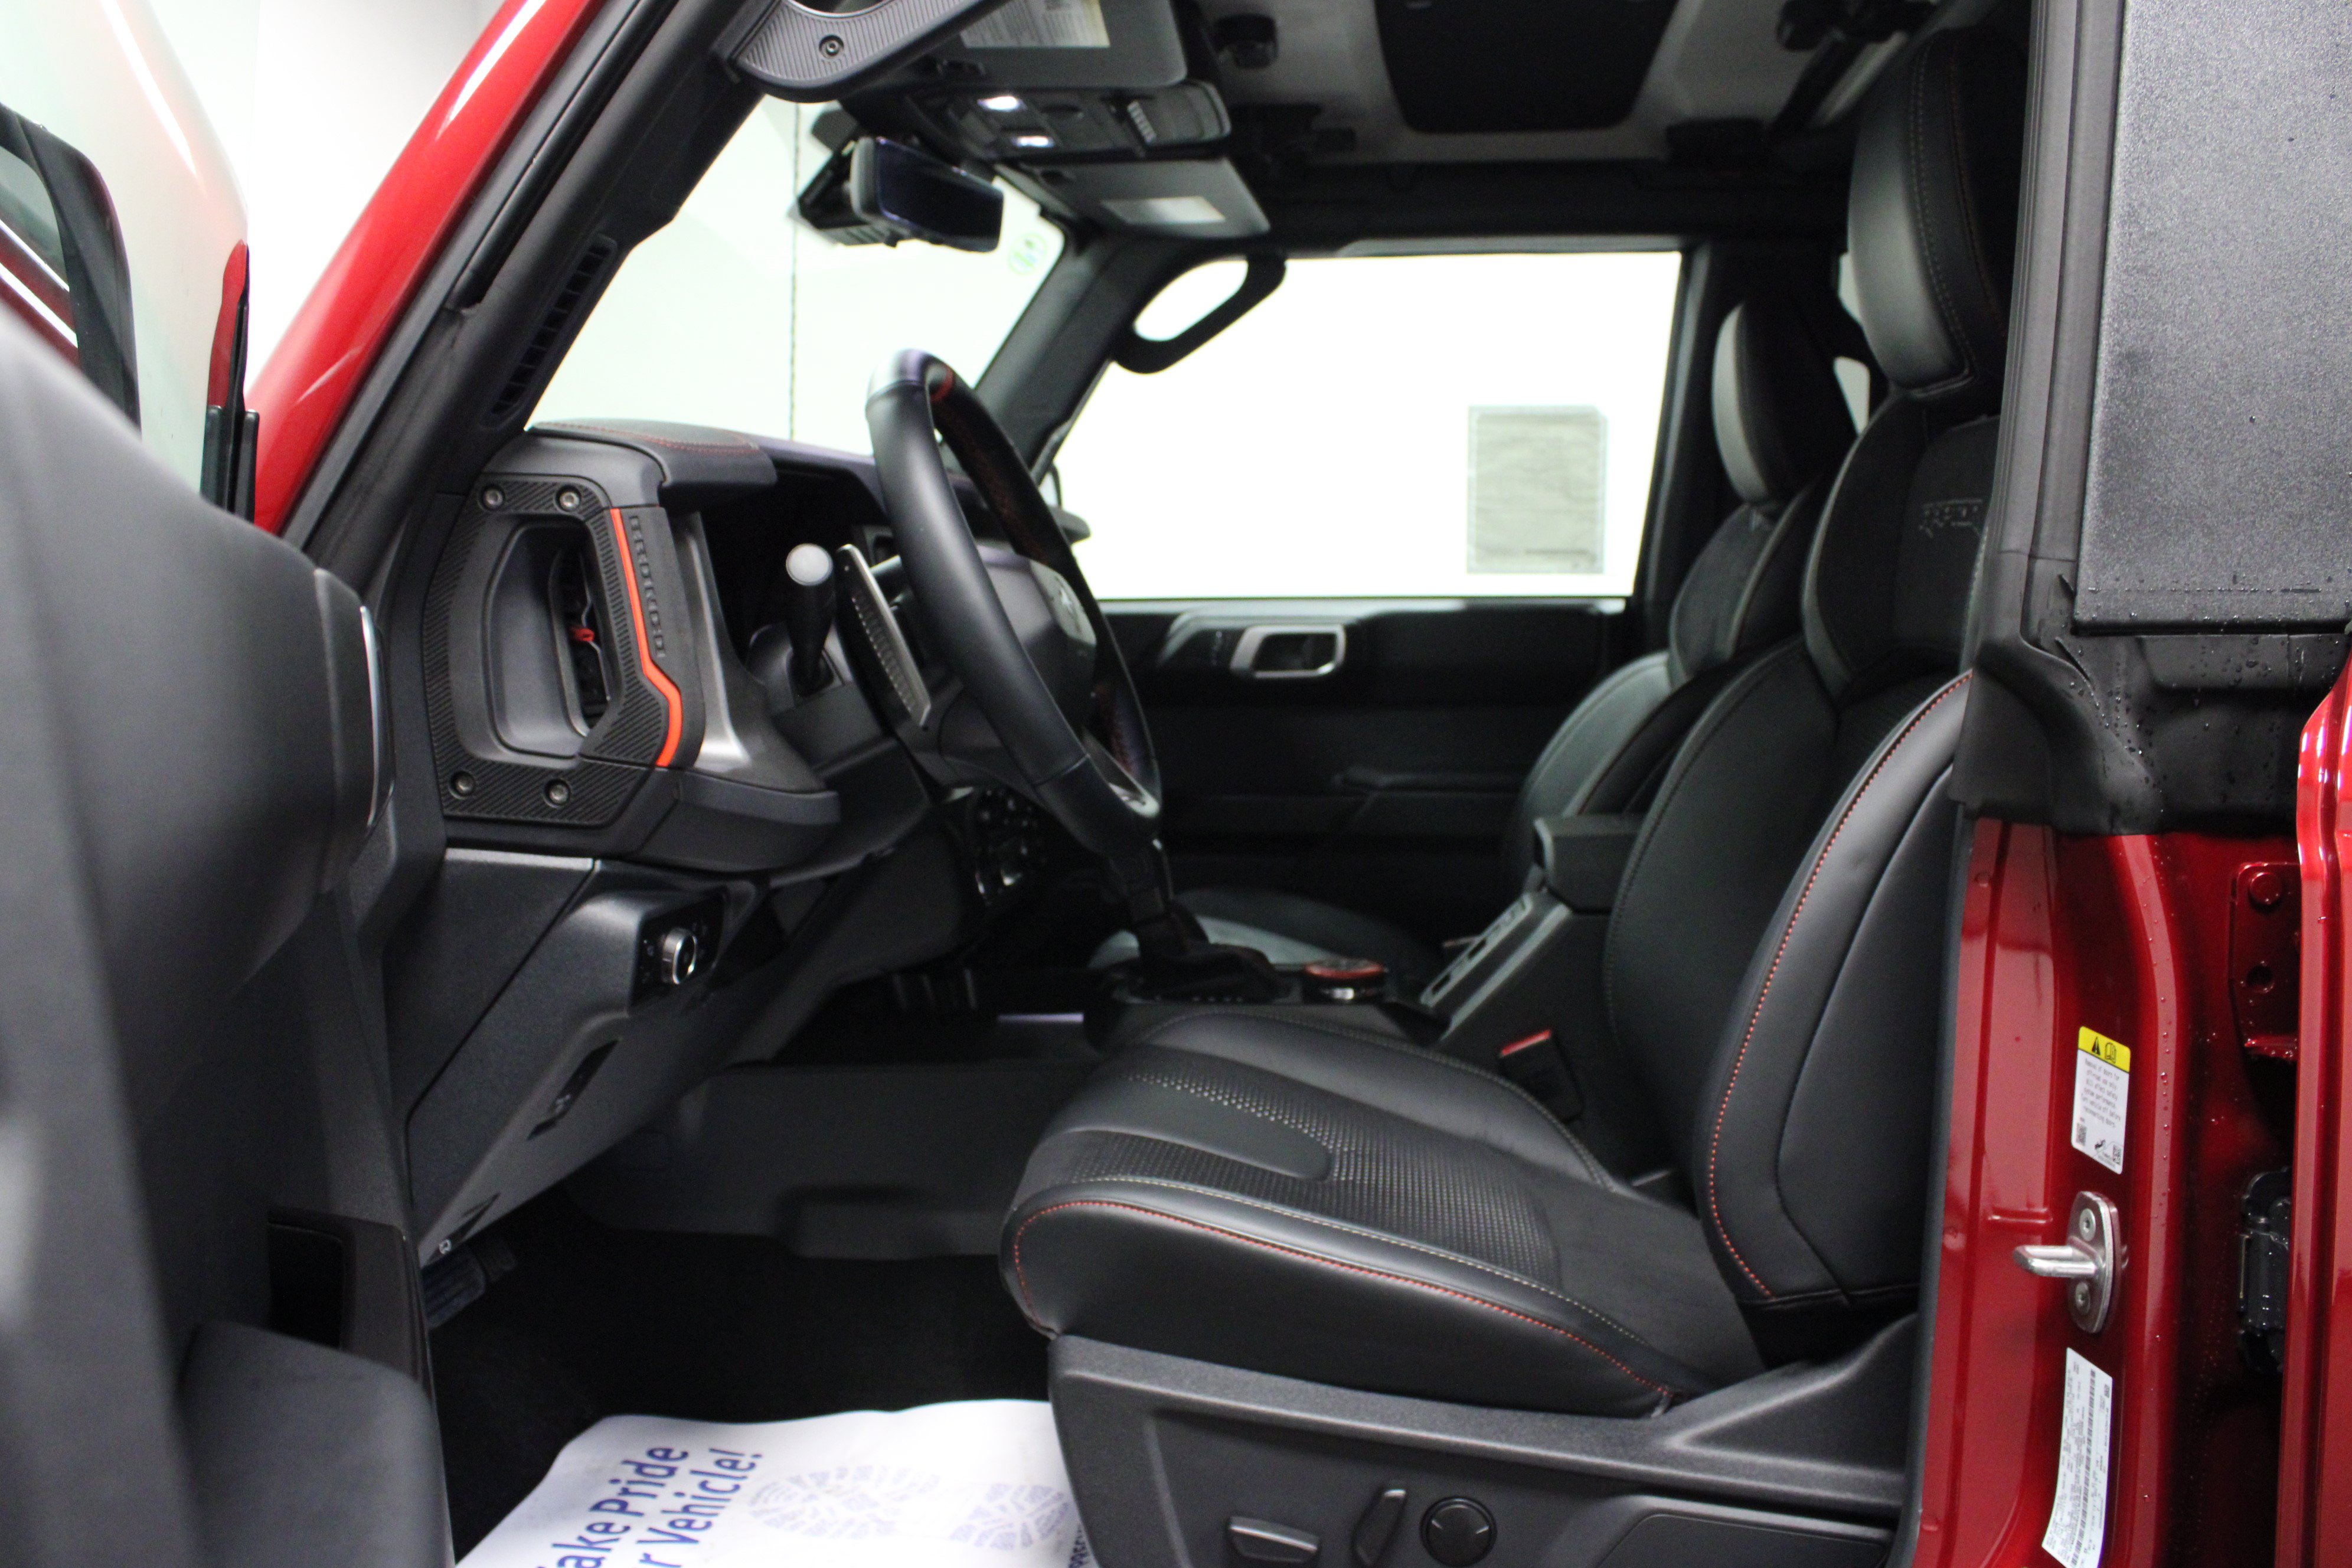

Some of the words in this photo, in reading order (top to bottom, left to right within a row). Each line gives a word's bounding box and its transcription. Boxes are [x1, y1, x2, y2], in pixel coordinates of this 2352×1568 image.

[534, 1521, 631, 1568] ake
[588, 1446, 689, 1517] Pride
[635, 1448, 763, 1544] Vehicle!
